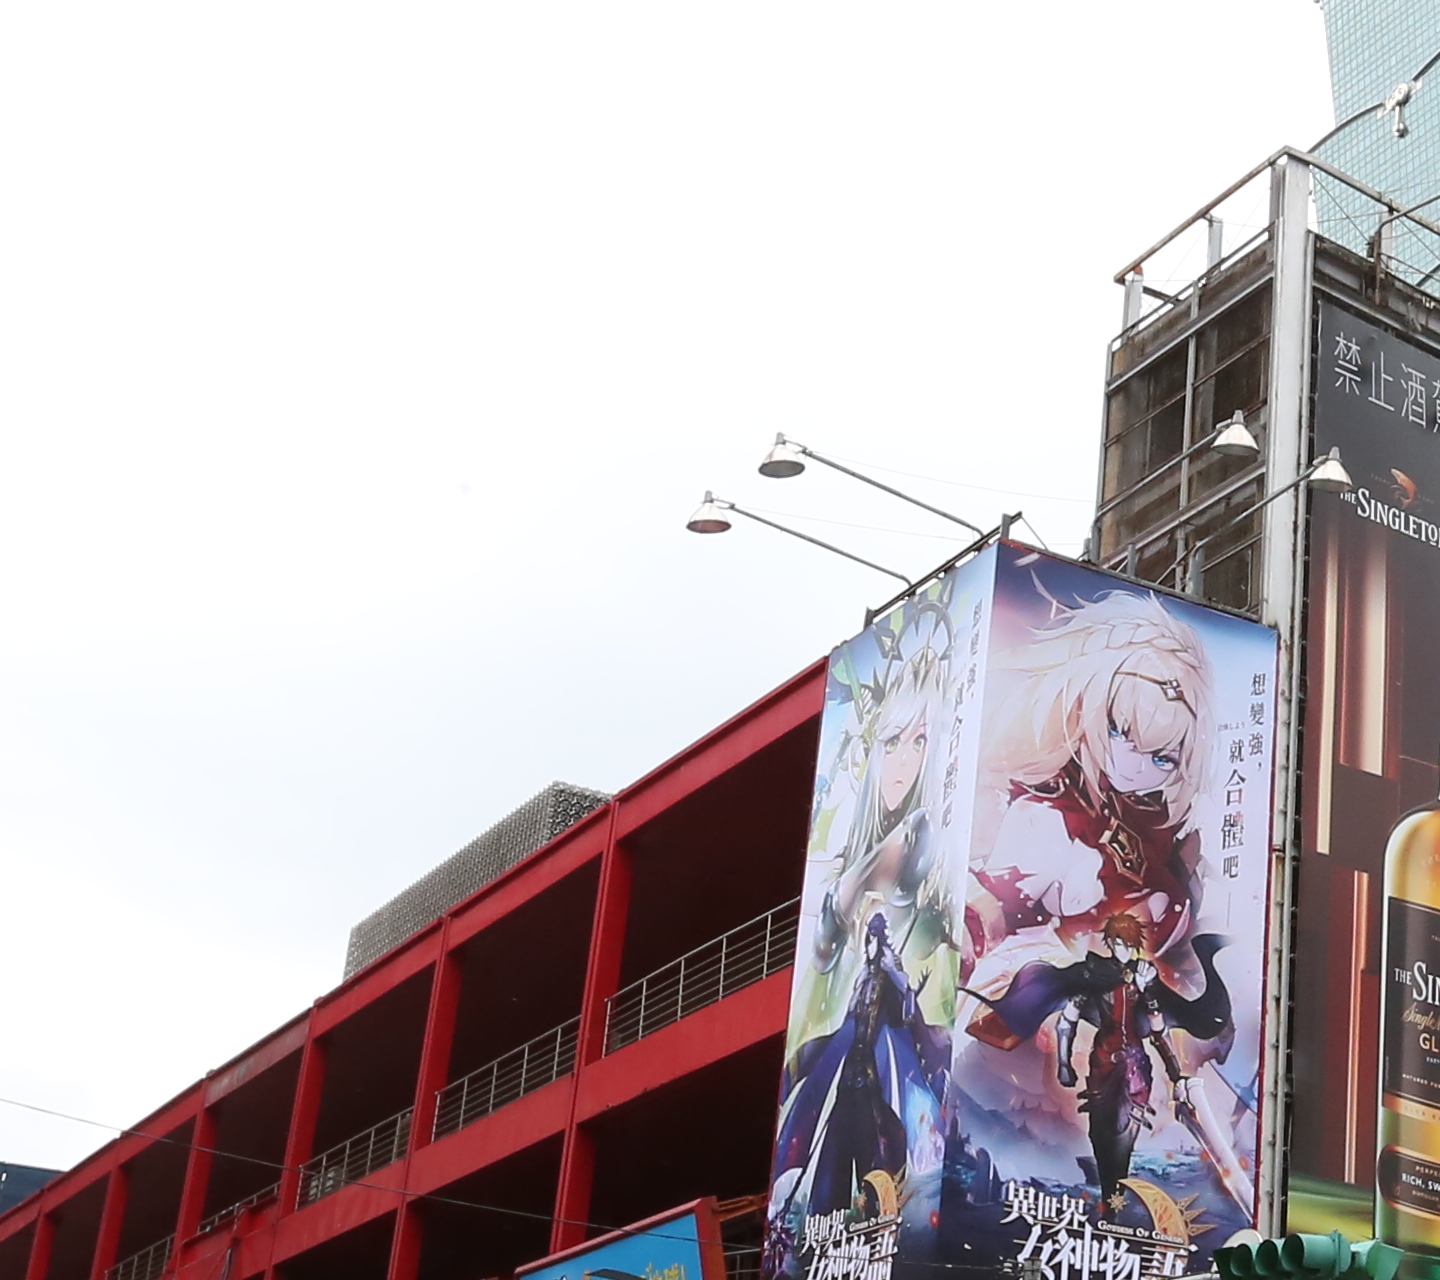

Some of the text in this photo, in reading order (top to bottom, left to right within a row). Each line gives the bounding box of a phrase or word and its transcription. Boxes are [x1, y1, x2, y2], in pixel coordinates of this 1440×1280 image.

[1394, 967, 1412, 987] THE
[1000, 1179, 1090, 1233] 異世界
